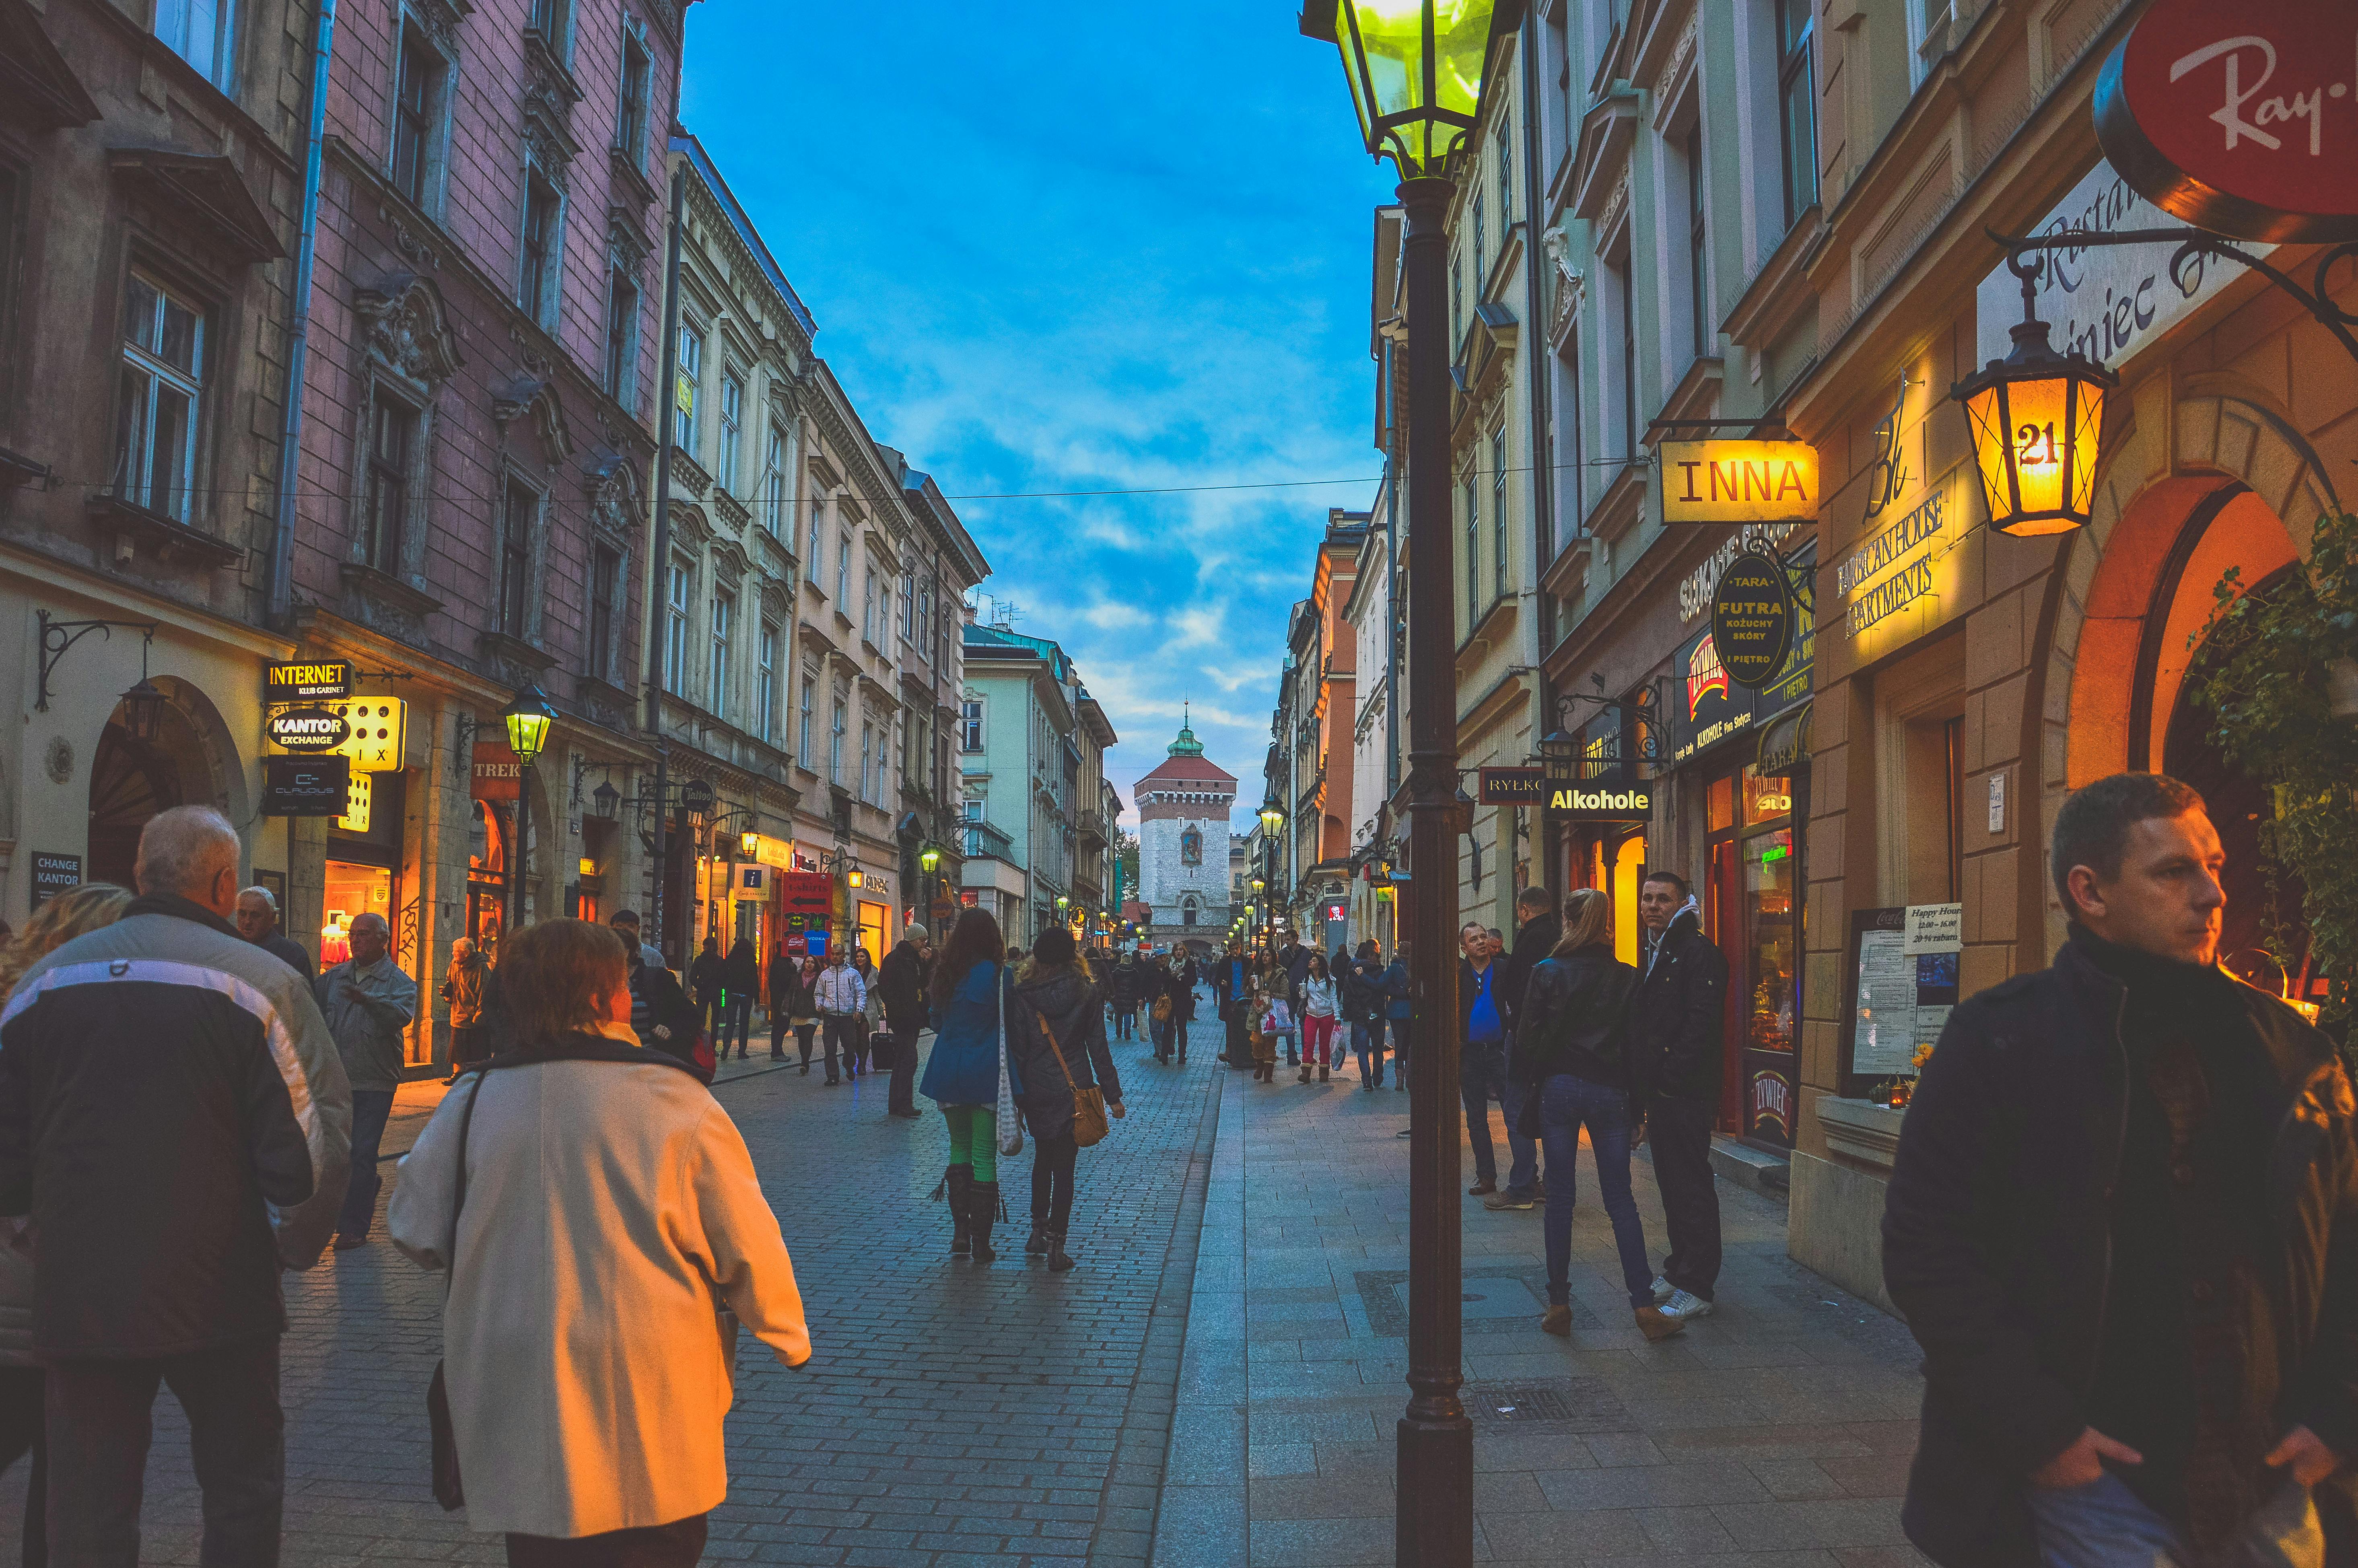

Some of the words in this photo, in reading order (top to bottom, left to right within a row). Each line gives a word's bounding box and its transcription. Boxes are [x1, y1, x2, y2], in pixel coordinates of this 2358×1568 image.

[2018, 421, 2058, 466] 21
[1678, 461, 1808, 502] INNA
[1897, 490, 1943, 560] HOUSE
[1734, 577, 1769, 587] TARA
[1719, 602, 1783, 615] FUTRA
[1726, 618, 1773, 628] KOŻUCHY
[1733, 630, 1766, 640] SKÓRY
[1734, 655, 1771, 665] PIĘTRO
[270, 665, 345, 684] INTERNET
[273, 719, 342, 733] KANTOR
[1697, 721, 1722, 749] ALKOHOLE
[1724, 721, 1733, 734] Piwa
[1734, 712, 1751, 729] Słodycze
[474, 764, 521, 777] TREK
[685, 787, 712, 800] Tattoo
[1550, 789, 1649, 810] Alkohole
[38, 858, 78, 870] CHANGE
[38, 872, 78, 885] KANTOR
[1911, 909, 1938, 919] Happy
[1938, 907, 1962, 915] Hours
[1913, 935, 1923, 943] 20
